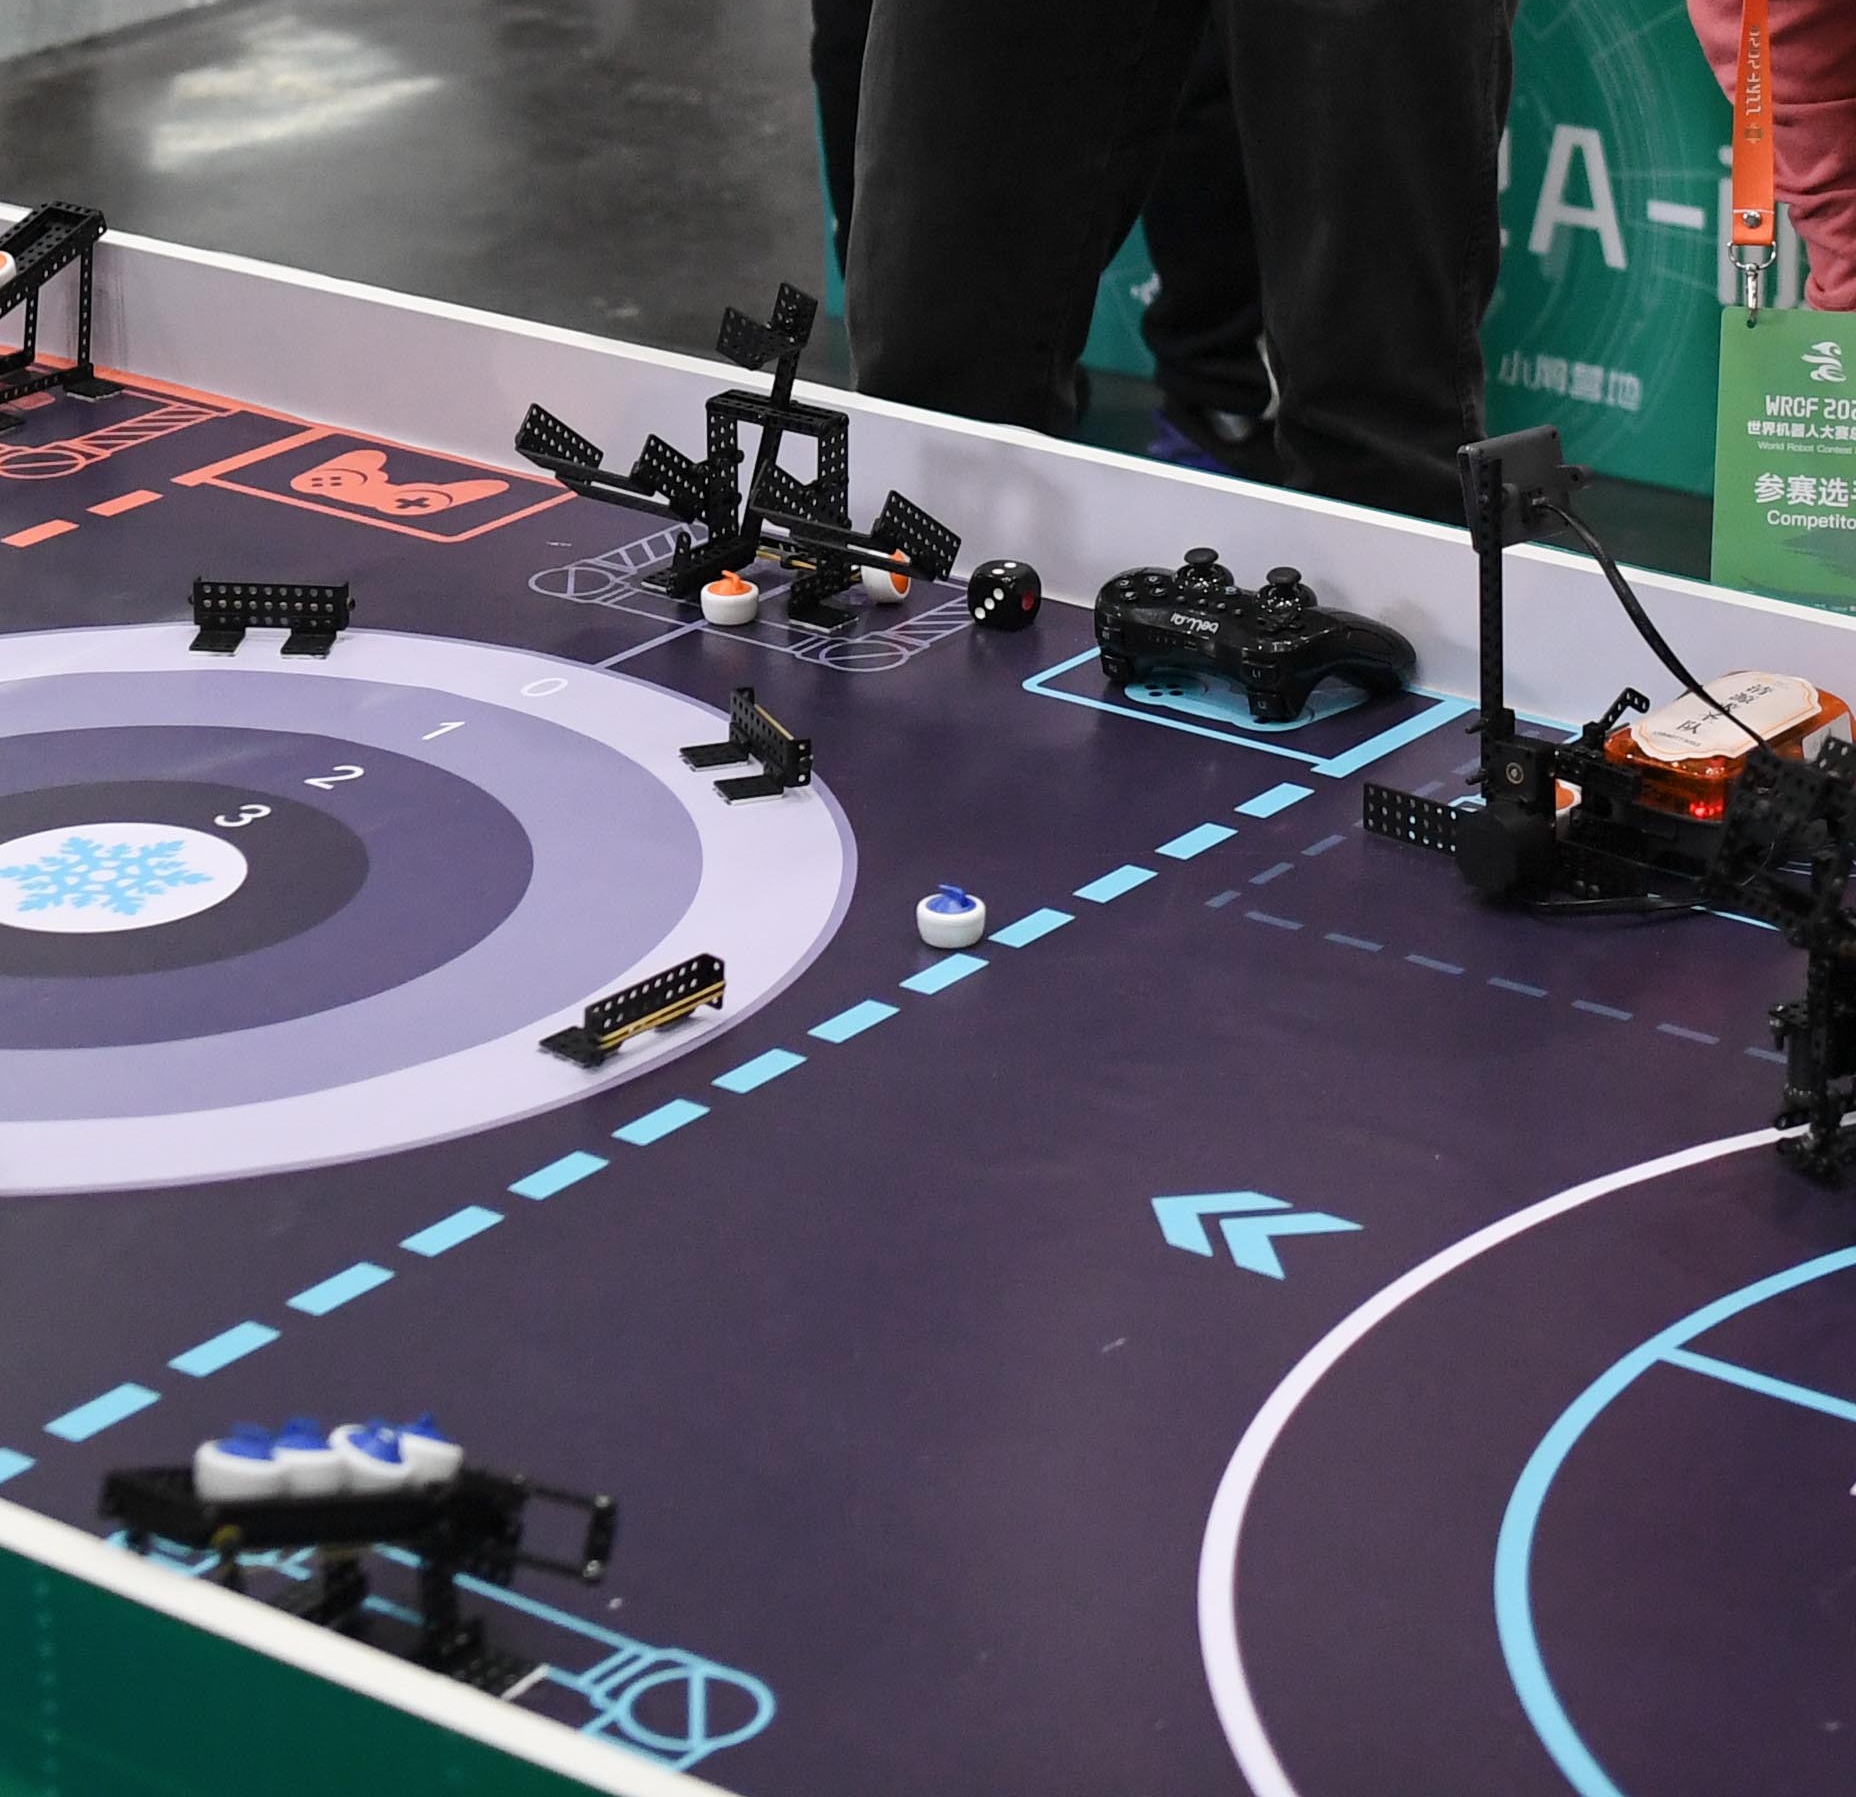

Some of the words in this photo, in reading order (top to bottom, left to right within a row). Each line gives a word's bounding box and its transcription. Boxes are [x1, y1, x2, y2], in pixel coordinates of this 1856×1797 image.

[1765, 393, 1819, 419] WRCF
[1757, 440, 1785, 452] World
[421, 720, 466, 741] 1
[304, 764, 365, 790] 2
[213, 803, 272, 828] 3
